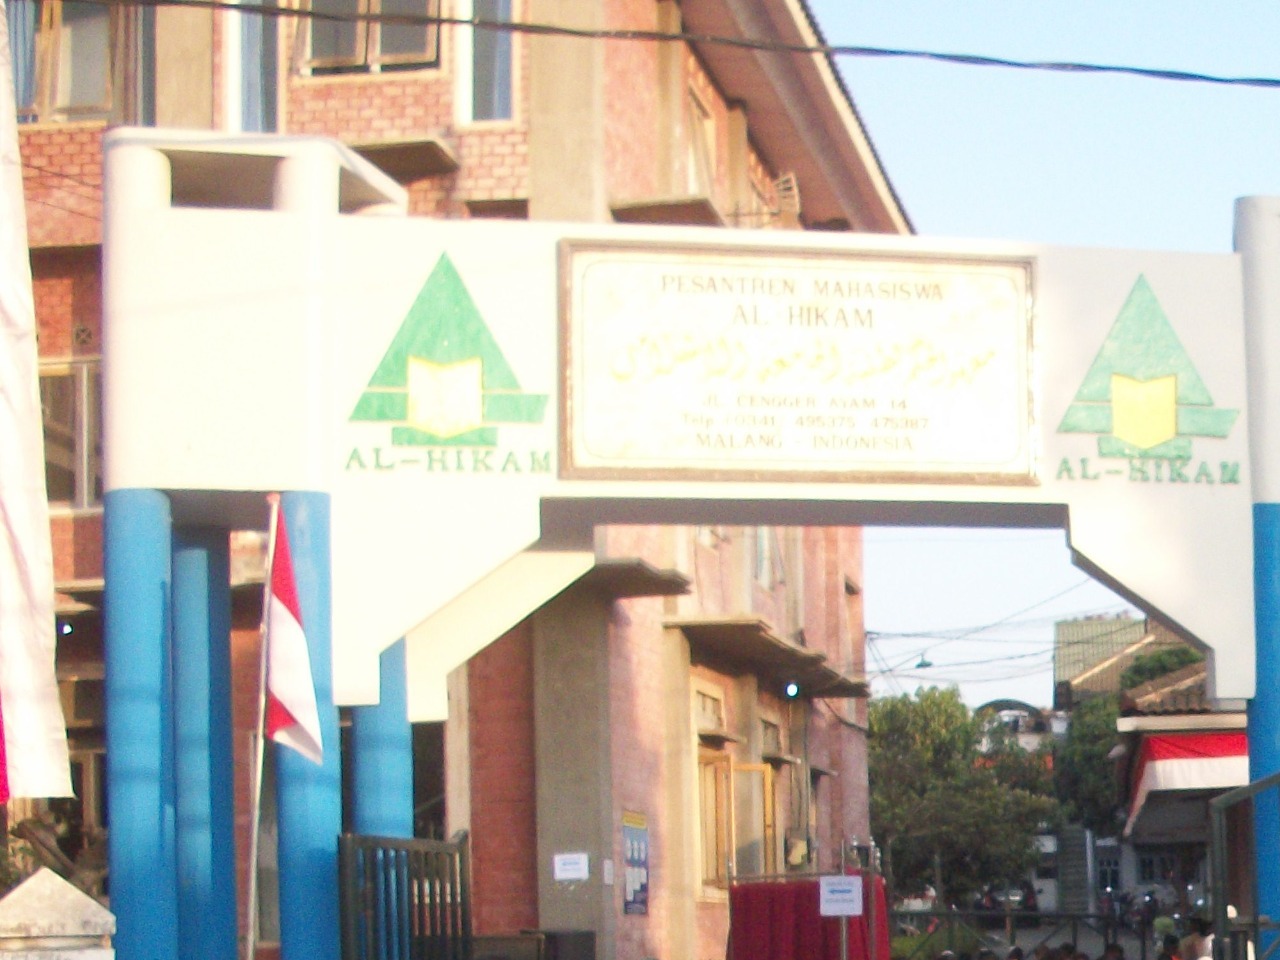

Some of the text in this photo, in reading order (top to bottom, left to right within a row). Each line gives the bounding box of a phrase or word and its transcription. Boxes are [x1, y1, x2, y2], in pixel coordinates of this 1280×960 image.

[661, 274, 944, 301] PESANTREN MAHASISWA
[732, 304, 875, 329] AL HIKAM
[695, 433, 783, 450] MALANG
[812, 434, 915, 452] INDONESIA
[345, 447, 552, 474] AL-HIKAM
[1055, 457, 1242, 485] AL-HIKAM
